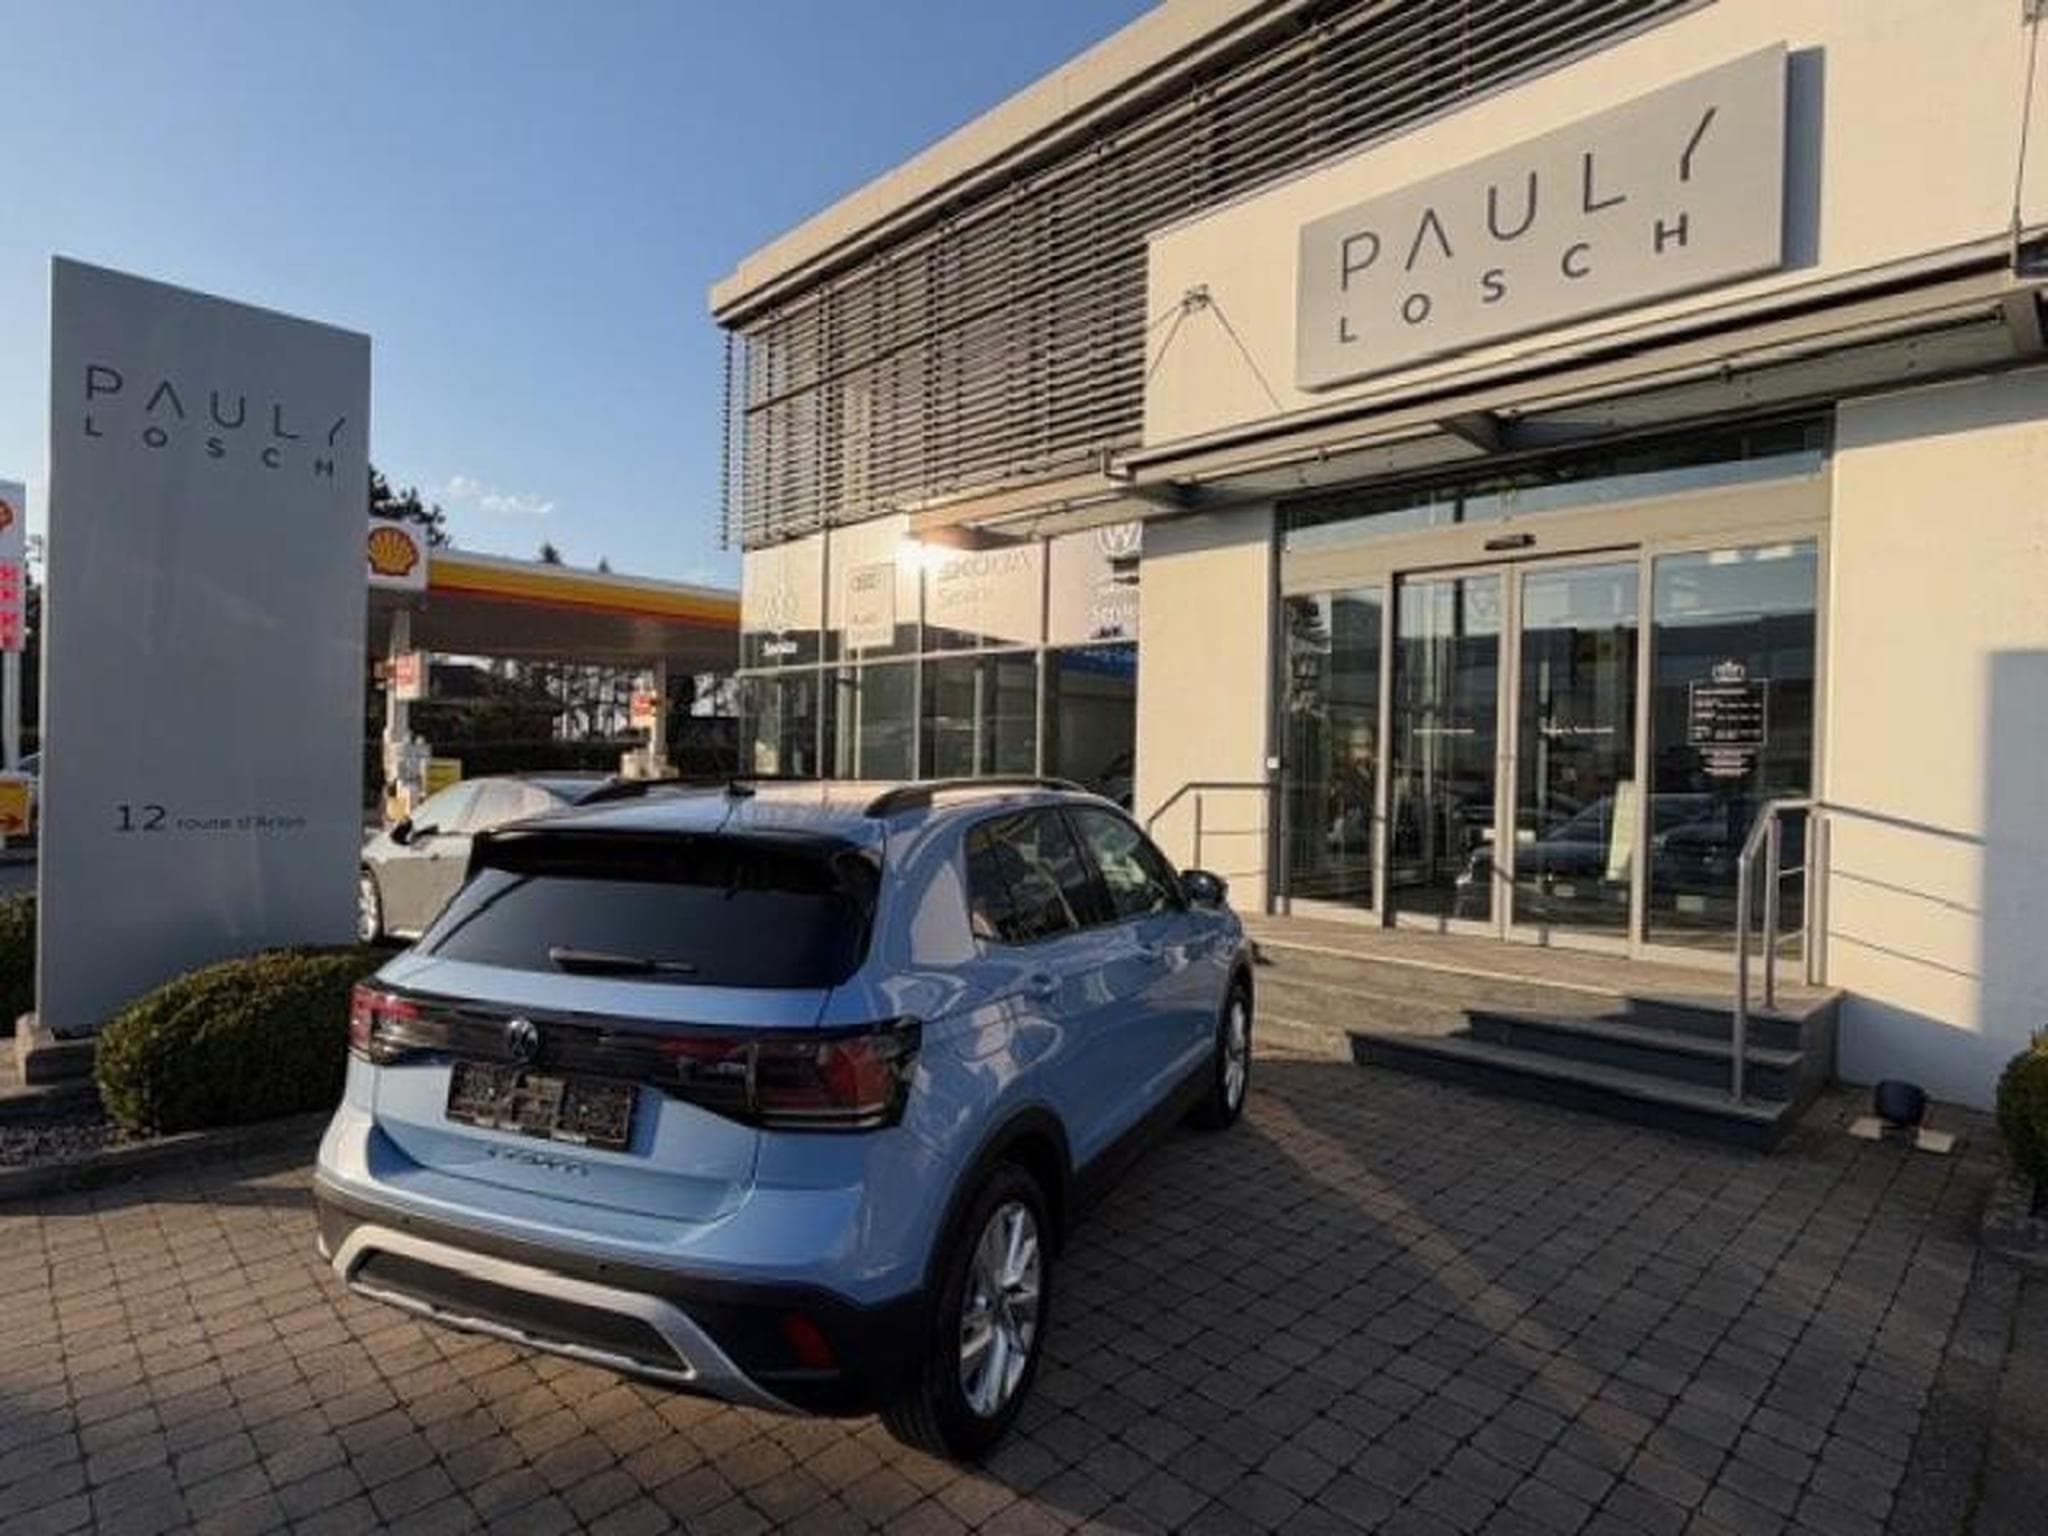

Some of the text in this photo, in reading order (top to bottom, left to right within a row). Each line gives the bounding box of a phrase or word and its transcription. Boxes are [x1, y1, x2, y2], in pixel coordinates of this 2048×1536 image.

[1341, 105, 1718, 292] PAULY
[1339, 212, 1689, 344] LOSCH
[84, 415, 334, 477] LOSCH
[85, 364, 346, 447] PAULY
[115, 804, 166, 832] 12
